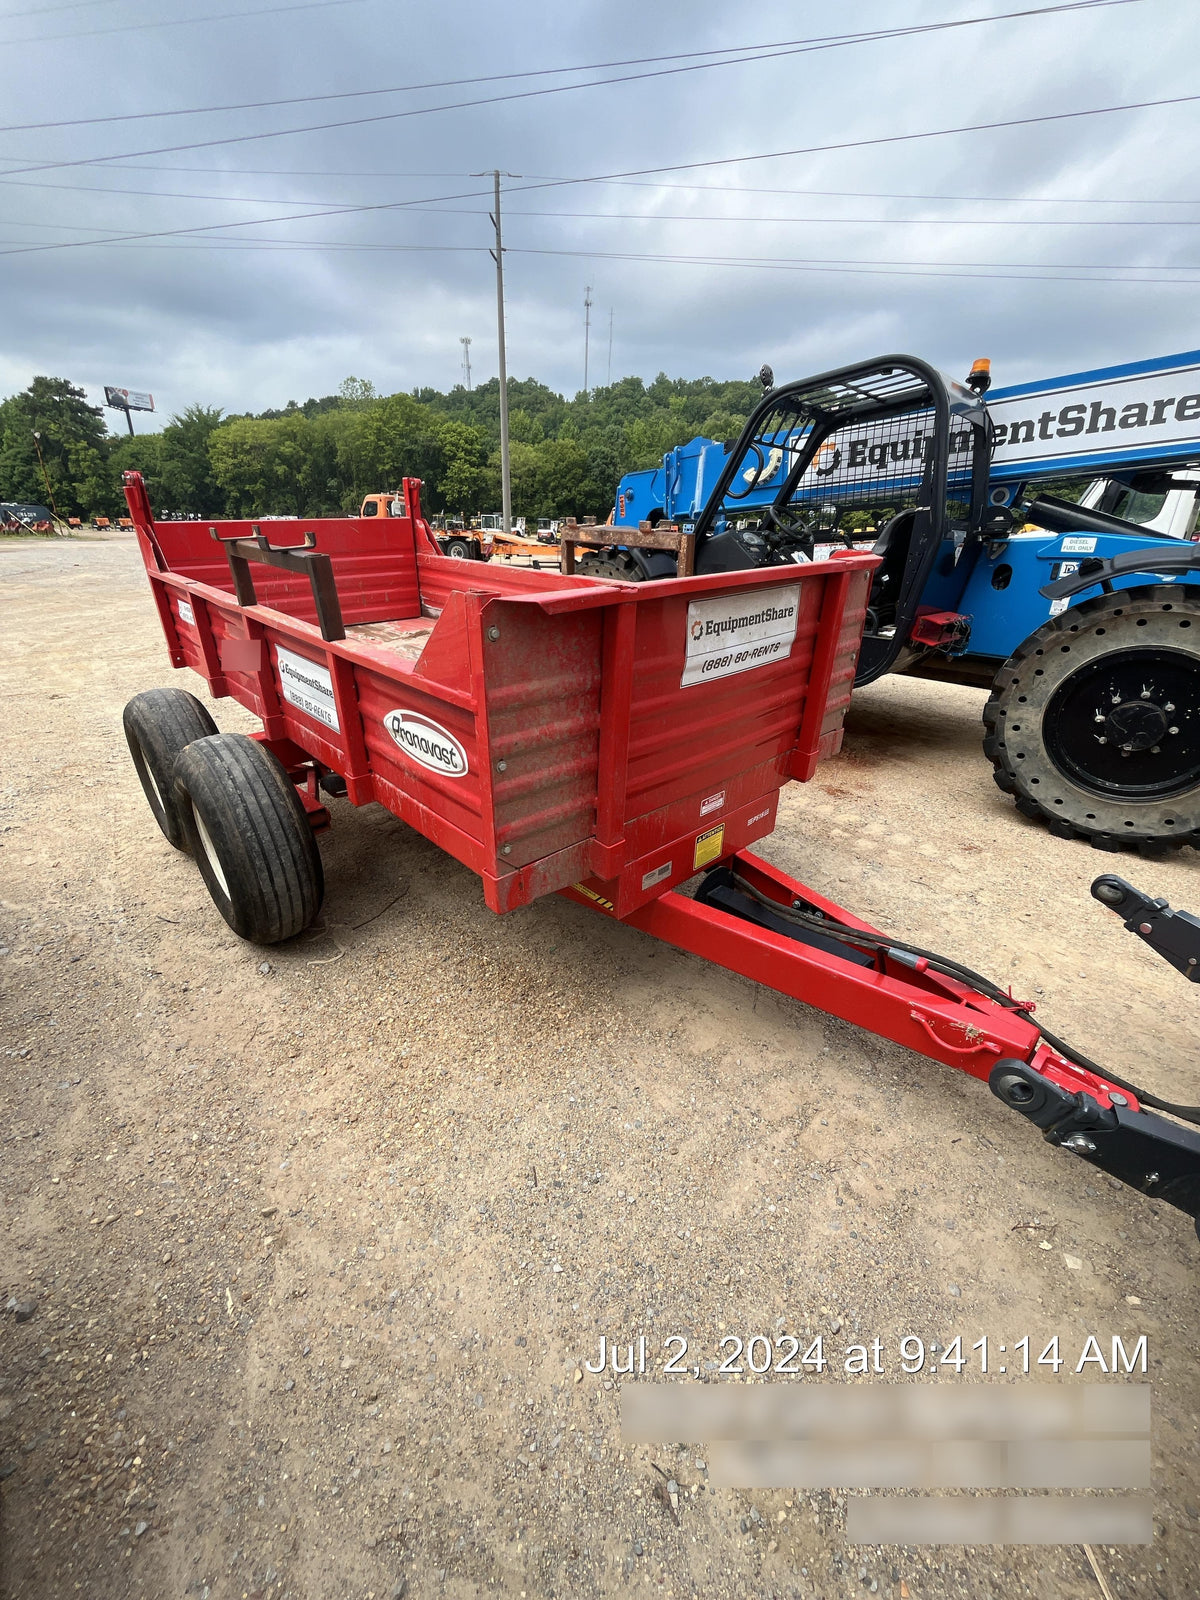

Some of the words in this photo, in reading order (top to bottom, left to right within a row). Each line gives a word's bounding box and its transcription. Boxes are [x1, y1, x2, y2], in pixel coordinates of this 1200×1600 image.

[705, 606, 794, 636] EquipmentShare
[702, 654, 733, 673] (888)
[734, 642, 781, 663] 80-RENTS
[285, 663, 334, 699] EquipmentShare
[304, 699, 332, 723] 80-RENTS
